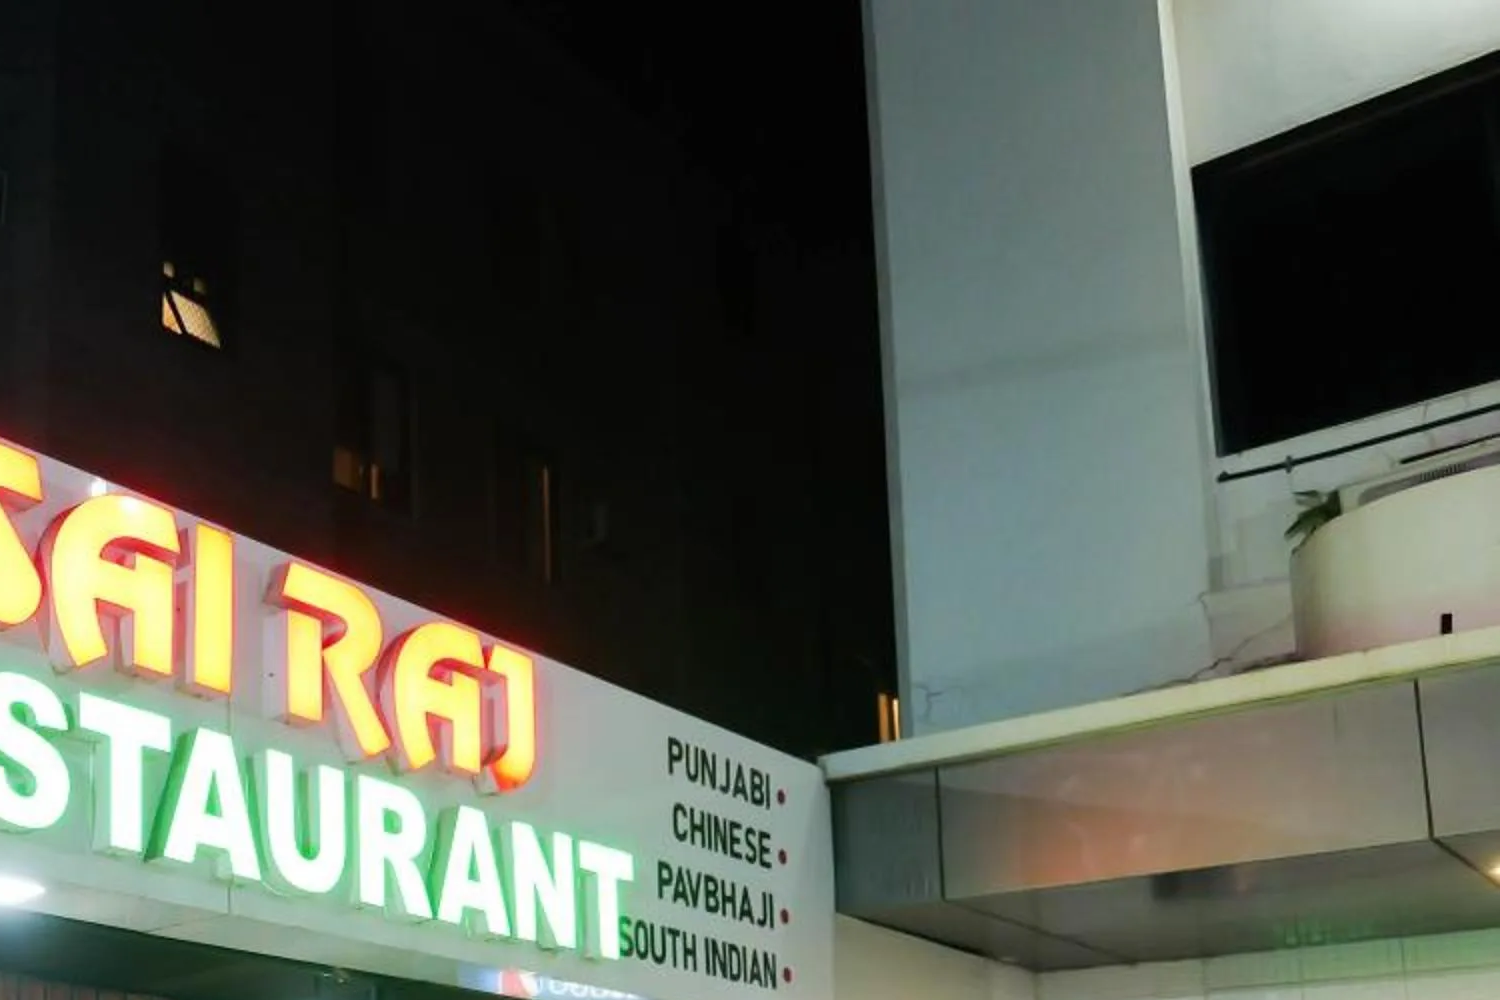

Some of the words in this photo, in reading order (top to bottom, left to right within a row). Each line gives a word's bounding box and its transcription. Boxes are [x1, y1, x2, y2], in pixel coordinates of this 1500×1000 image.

[266, 563, 537, 791] RAJ
[667, 736, 771, 810] PUNJABI
[672, 802, 772, 869] CHINESE
[657, 859, 774, 929] PAVBHAJI
[618, 915, 697, 972] SOUTH
[704, 937, 777, 989] INDIAN
